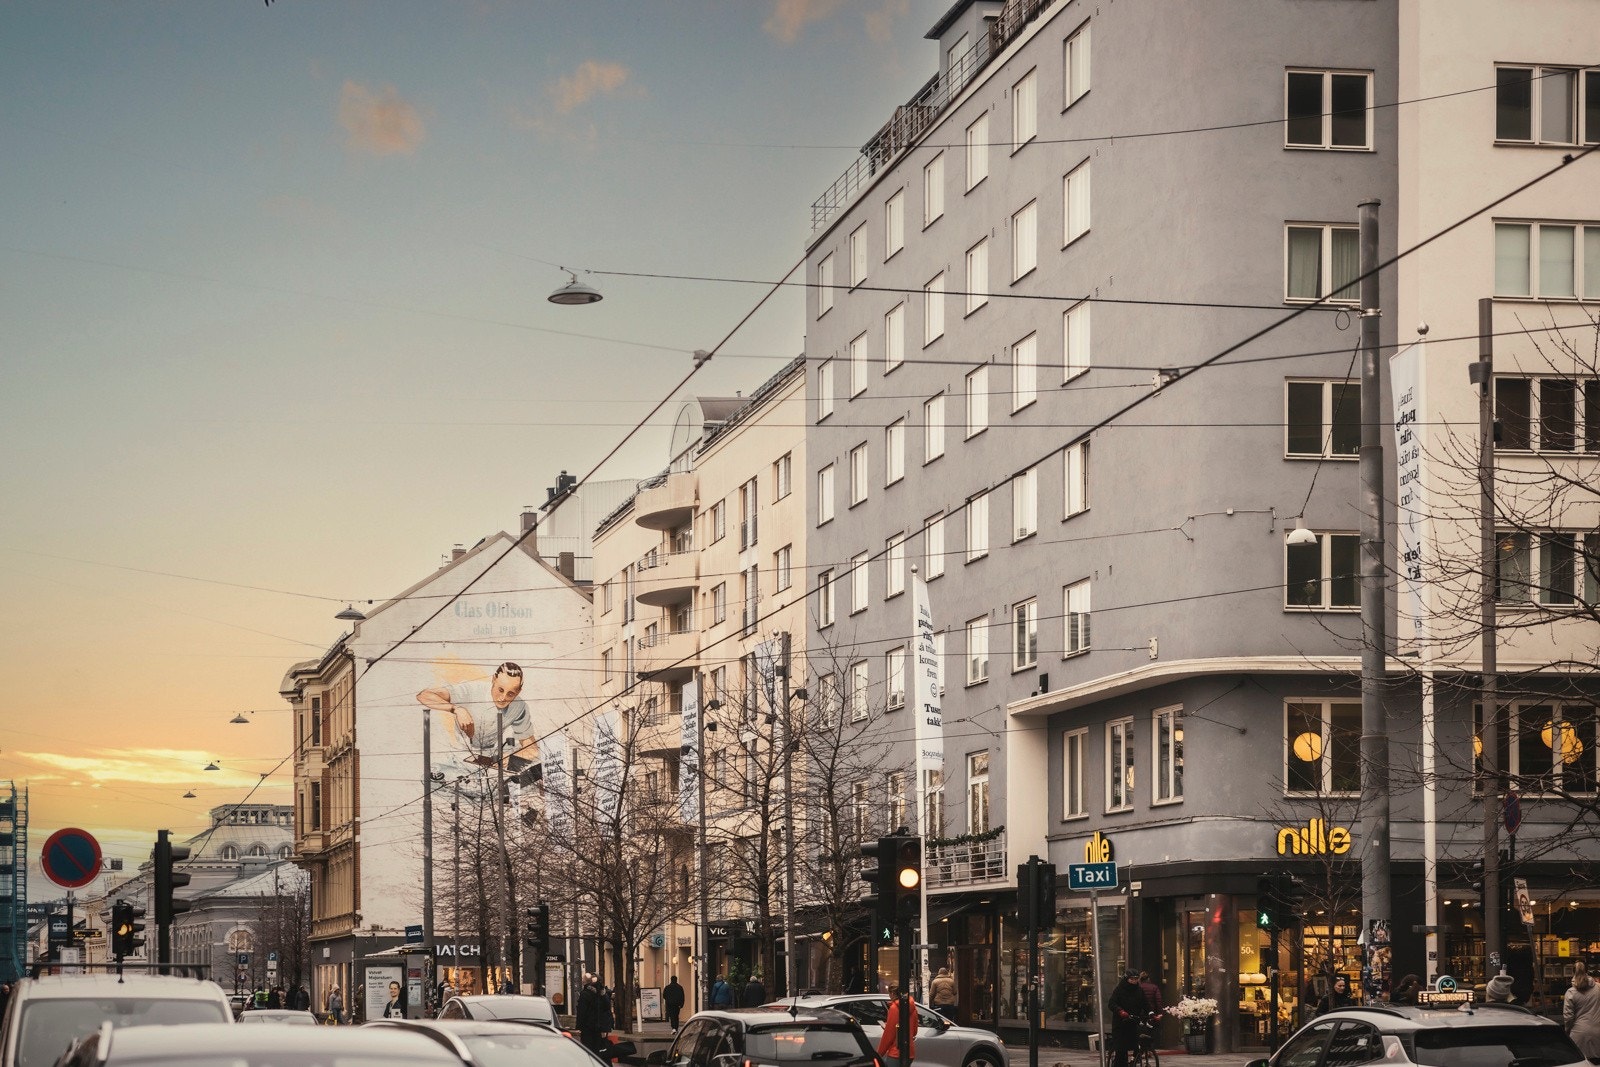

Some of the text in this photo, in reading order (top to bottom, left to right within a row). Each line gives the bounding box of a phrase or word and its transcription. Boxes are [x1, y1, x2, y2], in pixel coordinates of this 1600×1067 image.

[455, 601, 482, 617] Clas
[1085, 831, 1109, 864] nille
[1278, 818, 1351, 855] nille
[1075, 866, 1110, 883] Taxi
